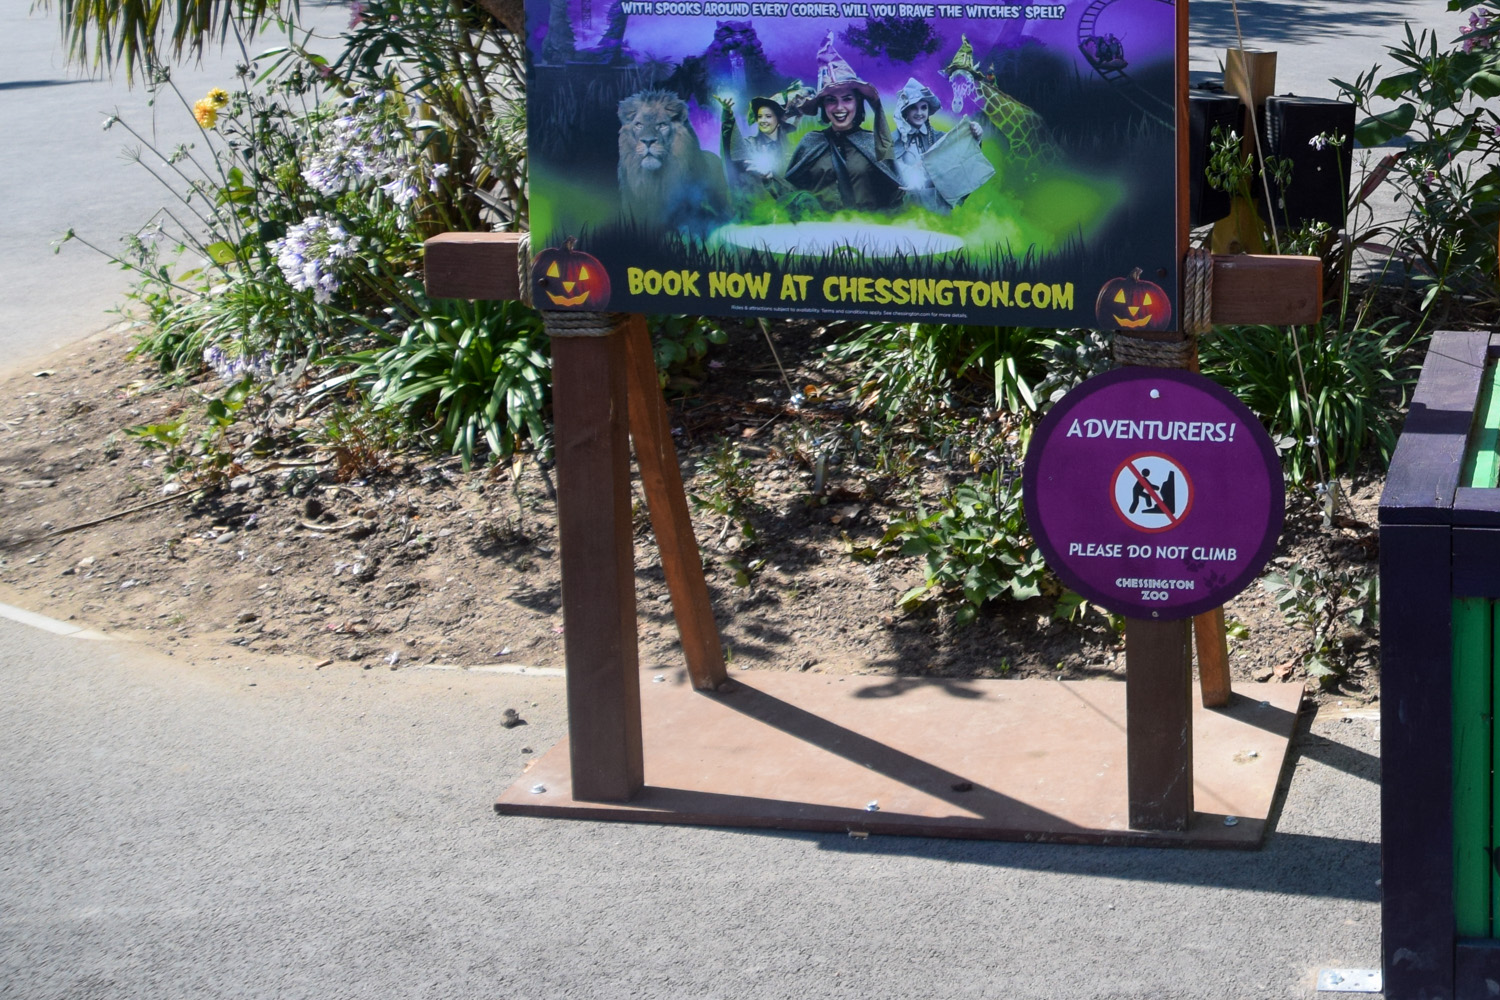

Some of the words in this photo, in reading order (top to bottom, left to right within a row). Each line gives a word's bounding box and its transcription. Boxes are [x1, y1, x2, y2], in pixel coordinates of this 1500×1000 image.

[621, 1, 652, 14] WITH
[655, 1, 701, 15] SPOOKS
[703, 2, 750, 16] AROUND
[752, 3, 789, 17] EVERY
[842, 4, 869, 17] WILL
[872, 4, 897, 17] YOU
[899, 4, 934, 18] BRAVE
[938, 5, 963, 18] THE
[1025, 5, 1066, 20] SPELL?
[627, 266, 701, 297] BOOK
[709, 271, 771, 300] NOW
[780, 273, 814, 301] AT
[822, 276, 1074, 311] CHESSINGTON.COM
[1066, 418, 1237, 443] ADVENTURERS!
[1069, 542, 1122, 558] PLEASE
[1126, 545, 1151, 559] DO
[1155, 546, 1189, 560] NOT
[1192, 547, 1237, 561] CLIMB
[1115, 577, 1195, 590] CHESSINGTON
[1141, 590, 1169, 601] ZOO
